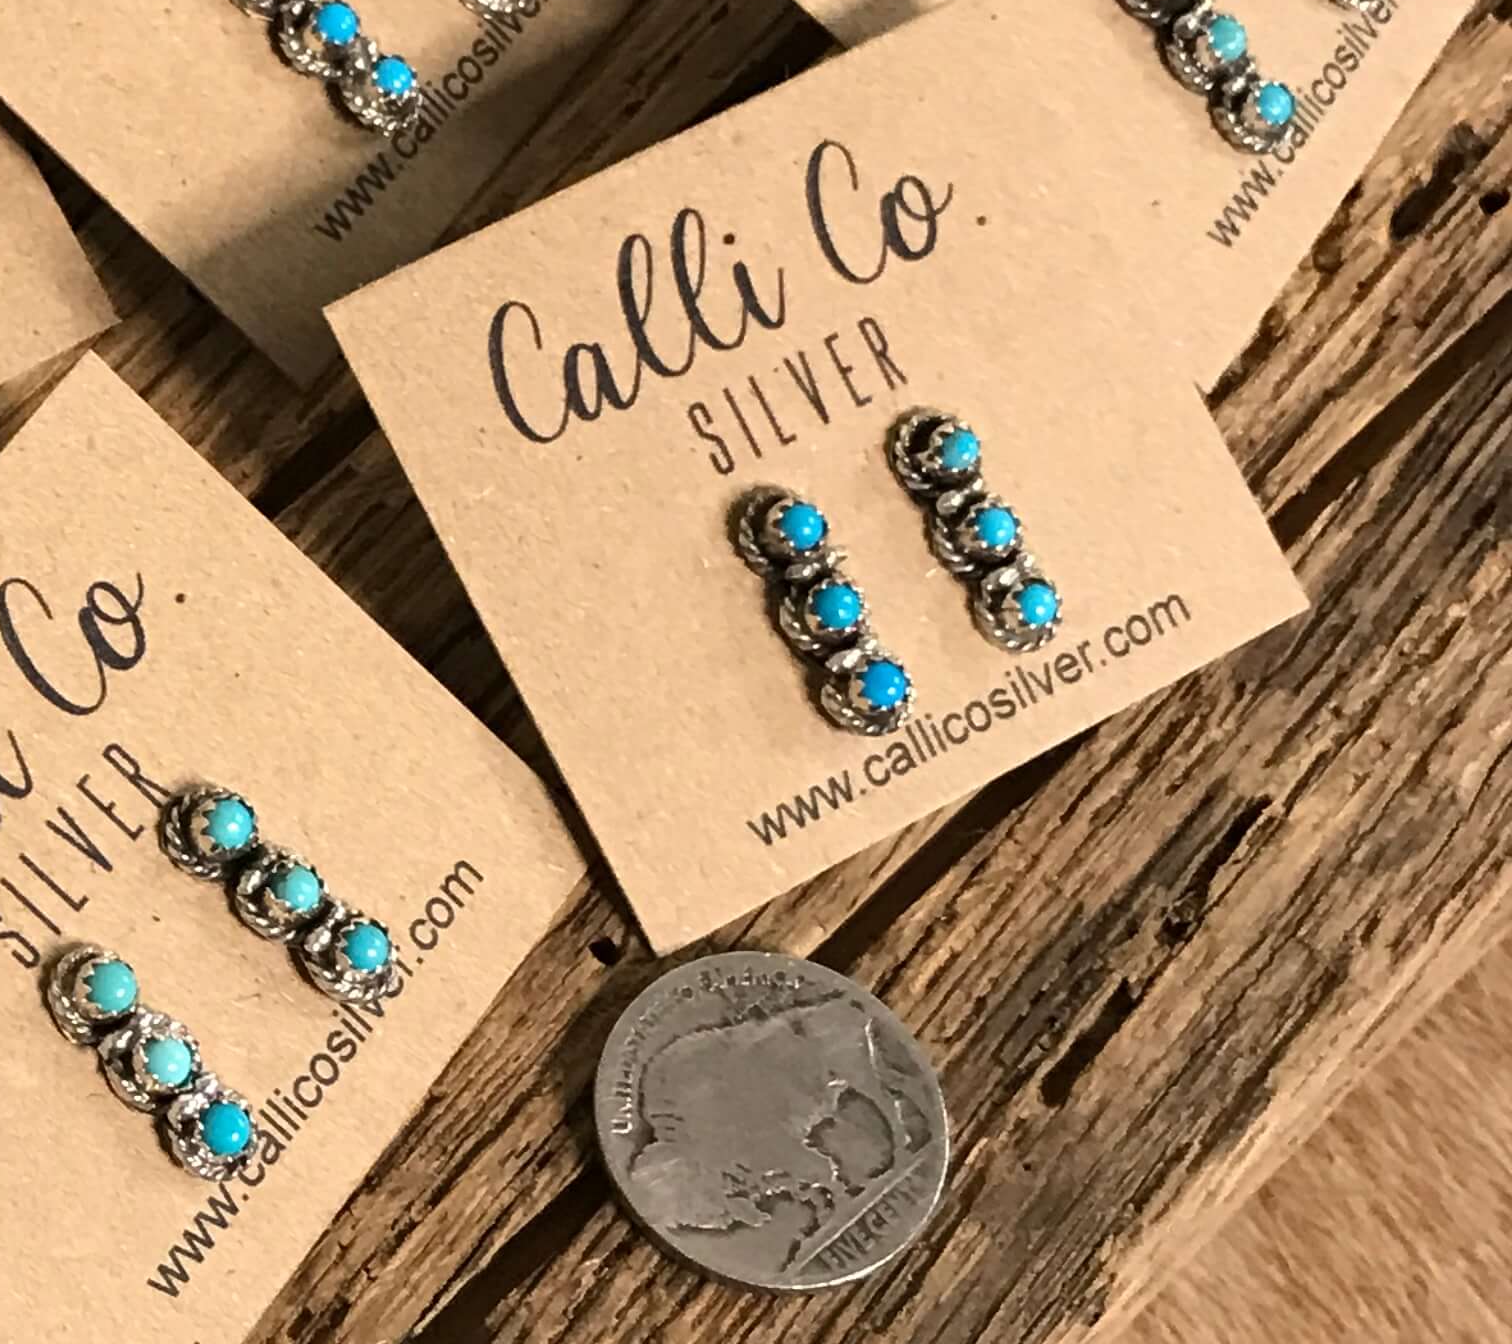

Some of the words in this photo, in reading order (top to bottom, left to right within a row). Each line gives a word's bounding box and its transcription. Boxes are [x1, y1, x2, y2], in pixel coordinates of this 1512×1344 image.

[487, 207, 787, 444] Calli
[687, 314, 908, 477] SILVER
[745, 590, 1194, 847] www.callicosilver.com
